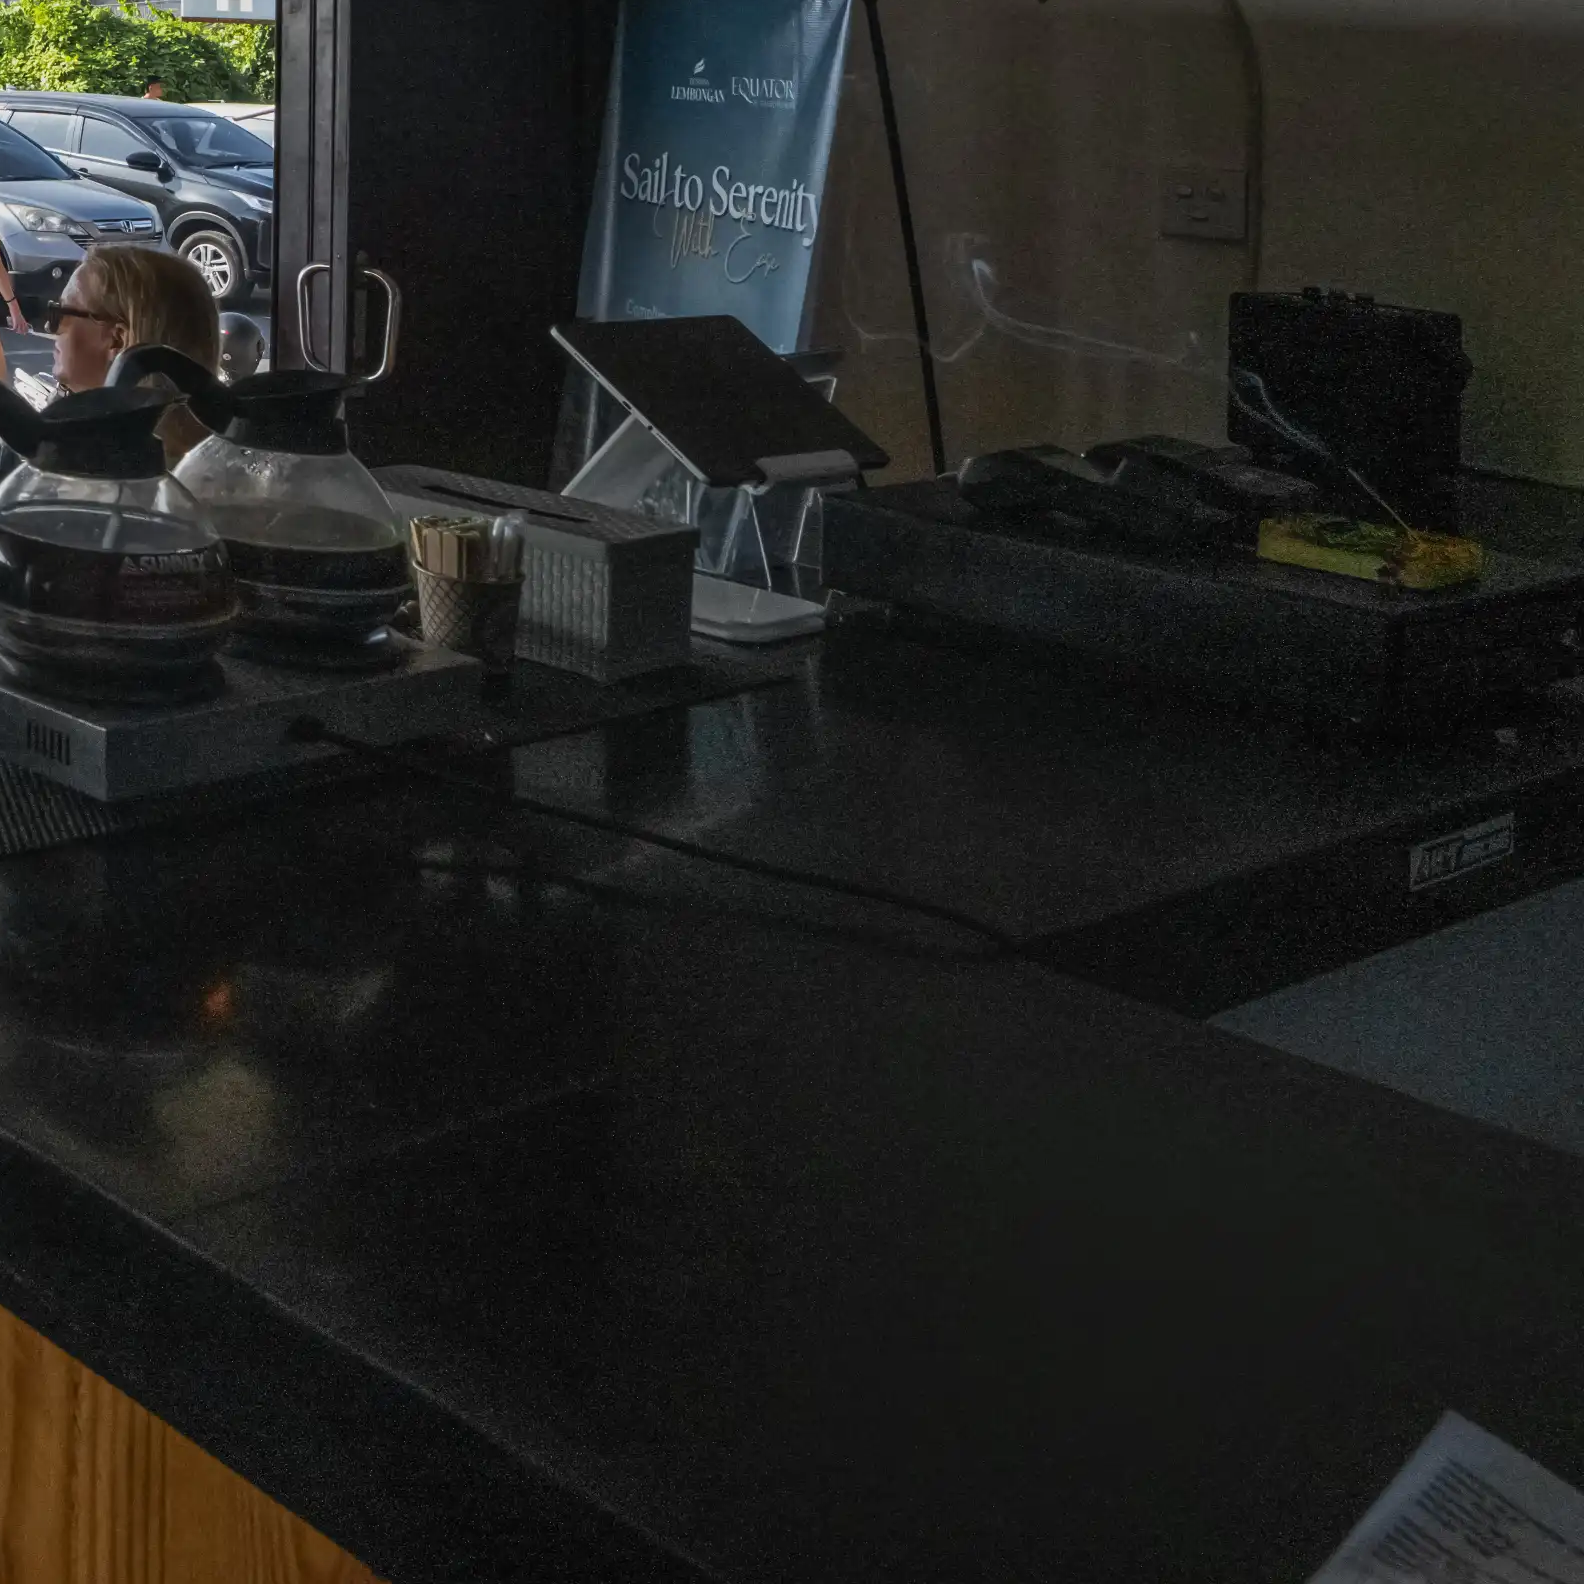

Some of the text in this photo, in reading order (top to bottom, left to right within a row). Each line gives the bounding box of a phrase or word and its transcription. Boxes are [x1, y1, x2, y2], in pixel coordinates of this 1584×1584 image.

[670, 85, 726, 103] LEMBONGAN
[732, 76, 795, 104] EQUATOR
[621, 151, 819, 247] Sail to Serenity
